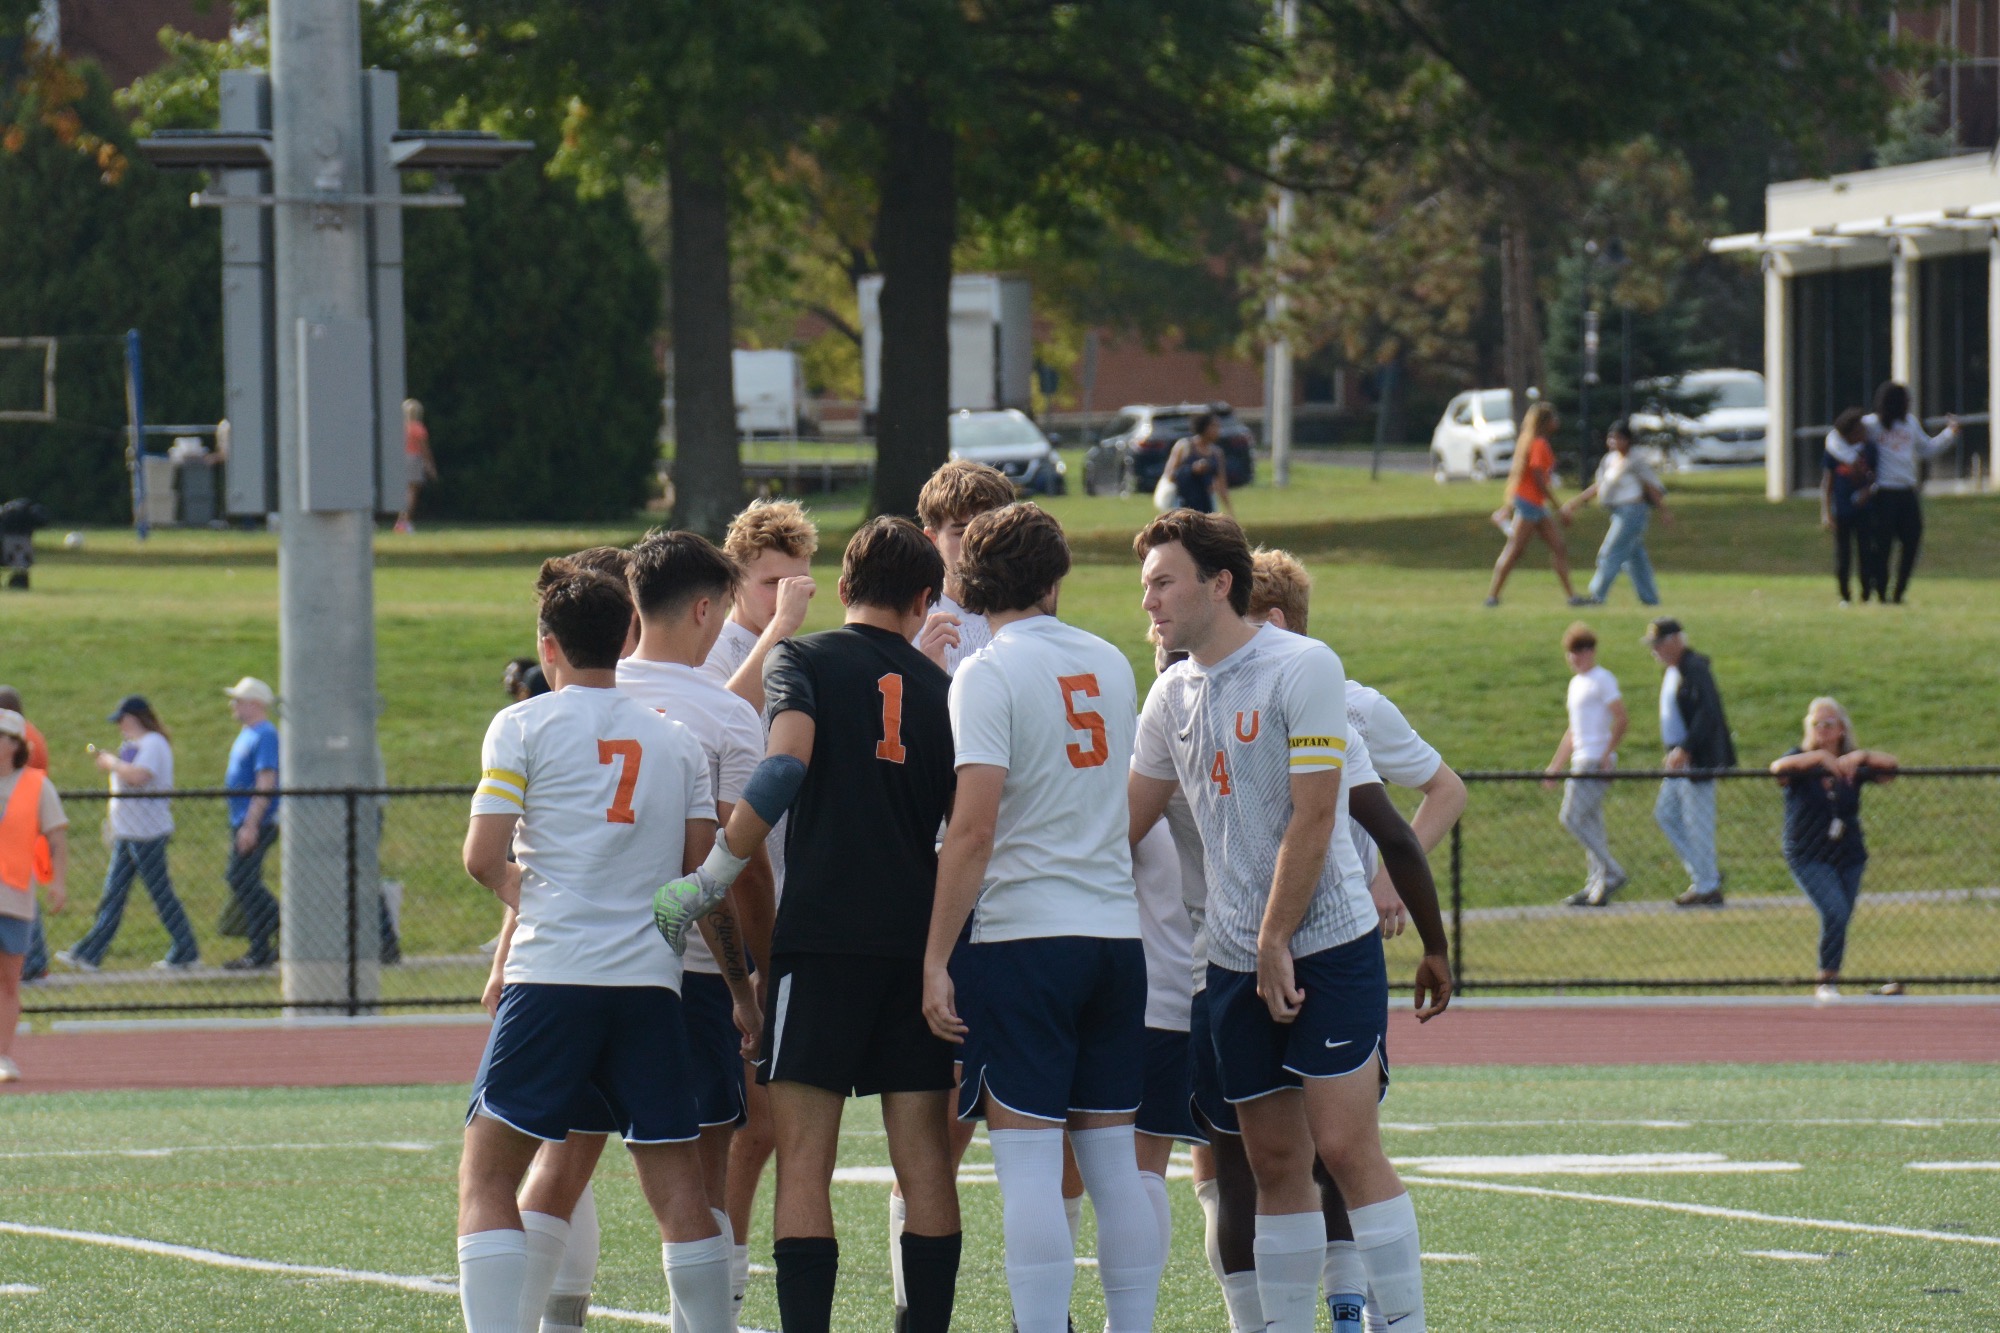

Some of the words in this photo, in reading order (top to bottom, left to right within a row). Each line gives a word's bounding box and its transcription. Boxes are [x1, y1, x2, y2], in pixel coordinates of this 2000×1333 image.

[876, 672, 906, 764] 1
[1057, 673, 1108, 769] 5
[1235, 710, 1259, 743] U
[598, 739, 643, 824] 7
[1211, 751, 1231, 796] 4
[1336, 1304, 1358, 1320] FS
